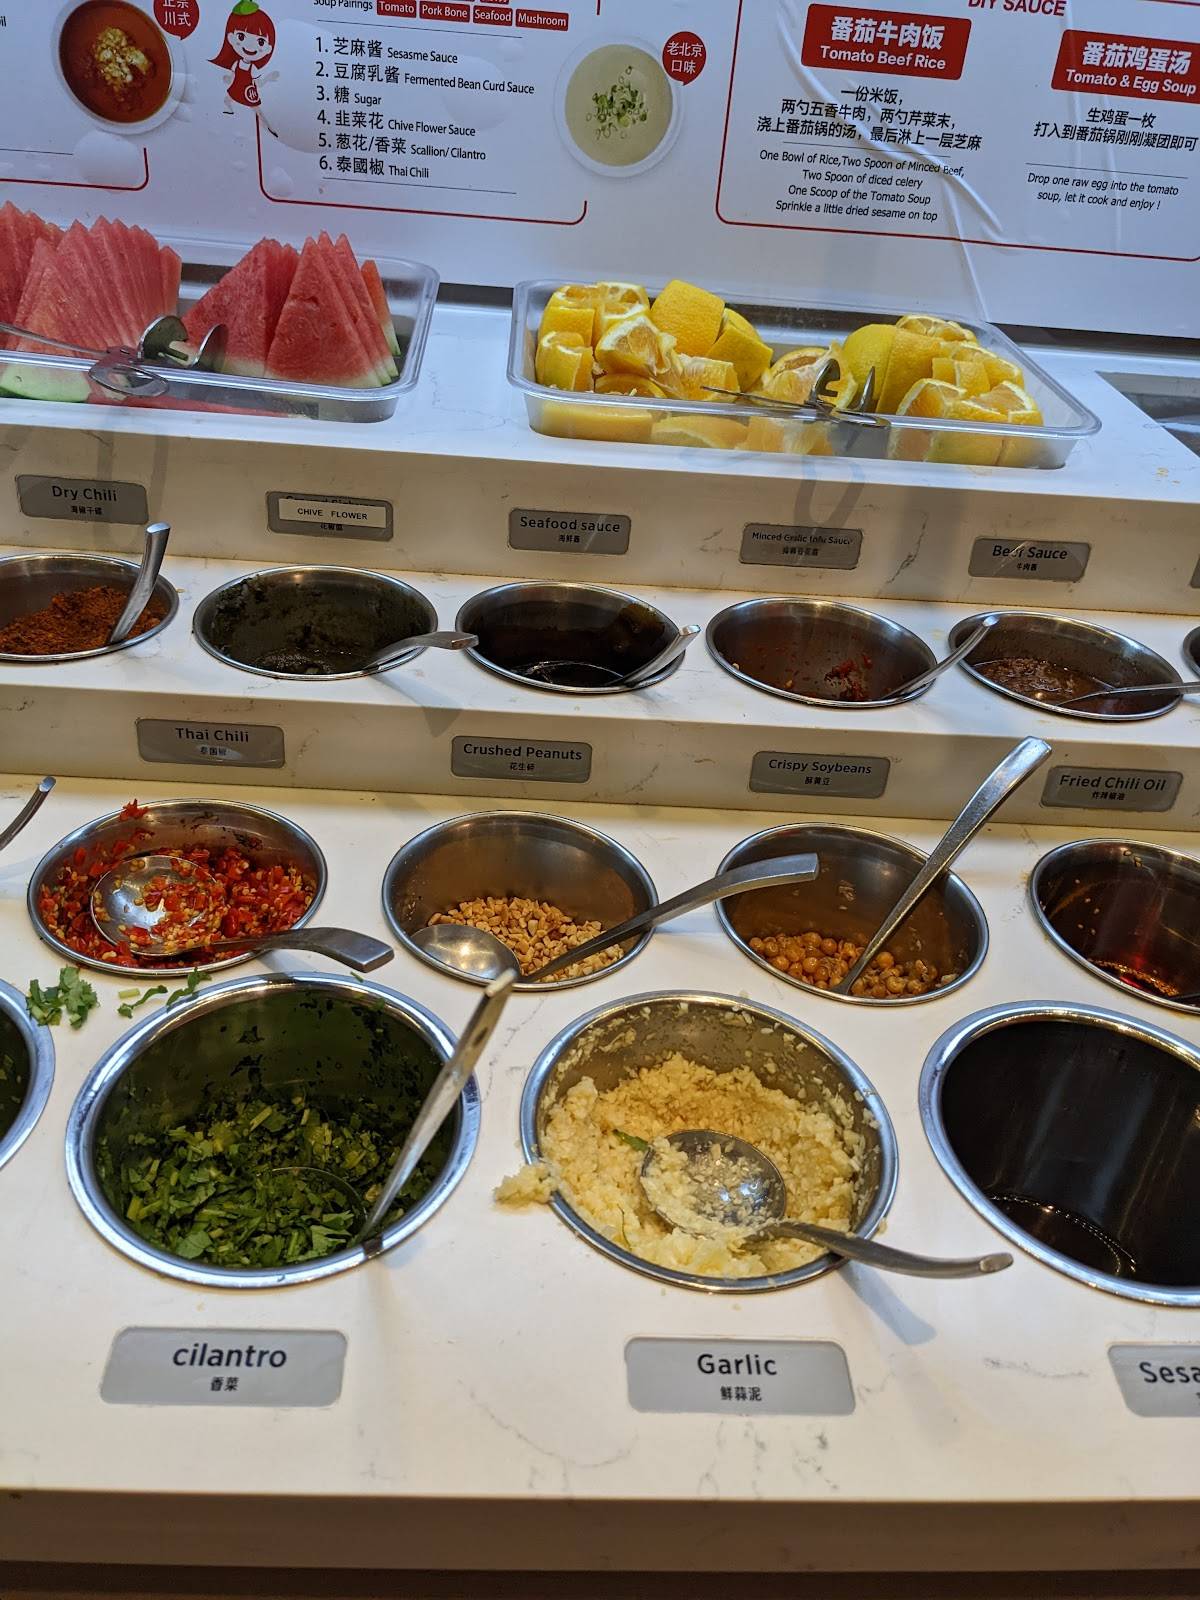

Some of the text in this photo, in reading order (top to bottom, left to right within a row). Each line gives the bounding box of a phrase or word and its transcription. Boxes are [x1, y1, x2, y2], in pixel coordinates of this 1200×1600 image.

[313, 0, 373, 11] Soup Pairings
[379, 1, 414, 13] Tomato
[422, 4, 468, 18] Pork Bone
[1003, 0, 1067, 16] SAUCE
[164, 11, 191, 27] 川式
[475, 9, 512, 22] Seafood
[518, 13, 567, 26] Mushroom
[831, 15, 945, 50] 番茄牛肉饭
[316, 37, 458, 64] 1. 芝麻酱 Sesasme Sauce
[667, 41, 704, 57] 老北京
[820, 45, 946, 70] Tomato Beef Rice
[671, 60, 696, 74] 口味
[1082, 41, 1192, 76] 番茄鸡蛋汤
[316, 61, 535, 94] 2. 豆腐乳酱 Fermented Bean Curd Sauce
[1066, 68, 1197, 97] Tomato & Egg Soup
[316, 85, 382, 107] 3. 糖 Sugar
[317, 109, 476, 137] 4. 韭菜花 Chive Flower Sauce
[1086, 107, 1157, 129] 生鸡蛋一枚
[318, 133, 332, 148] 5.
[411, 144, 449, 158] Scallion/
[451, 148, 486, 160] Cilantro
[319, 155, 429, 178] 6. 泰國椒 Thai Chili
[760, 149, 779, 161] One
[782, 152, 805, 163] Bowl
[807, 153, 818, 164] of
[864, 157, 893, 170] Spoon
[895, 160, 907, 170] of
[907, 161, 941, 173] Minced
[943, 165, 965, 178] Beef,
[802, 169, 923, 190] Two Spoon of diced celery
[1027, 172, 1179, 196] Drop one raw egg into the tomato
[788, 184, 931, 207] One Scoop of the Tomato Soup
[1037, 191, 1062, 203] soup,
[1064, 192, 1077, 203] let
[1078, 193, 1086, 204] it
[1087, 195, 1109, 206] cook
[1110, 196, 1127, 207] and
[1129, 199, 1155, 212] enjoy
[776, 199, 938, 223] Sprinkle a little dried sesame on top
[51, 485, 117, 502] Dry Chili
[297, 507, 368, 520] CHIVE FLOWER
[520, 516, 621, 533] Seafood sauce
[752, 532, 782, 542] Minced
[1027, 546, 1068, 560] Sauce
[175, 728, 249, 742] Thai Chili
[463, 743, 582, 760] Crushed Peanuts
[768, 759, 872, 774] Crispy Soybeans
[1060, 774, 1167, 791] Fried Chili Oil
[172, 1343, 288, 1368] cilantro
[696, 1353, 778, 1376] Garlic
[209, 1376, 240, 1392] 香菜
[719, 1385, 763, 1402] 鲜蒜泥
